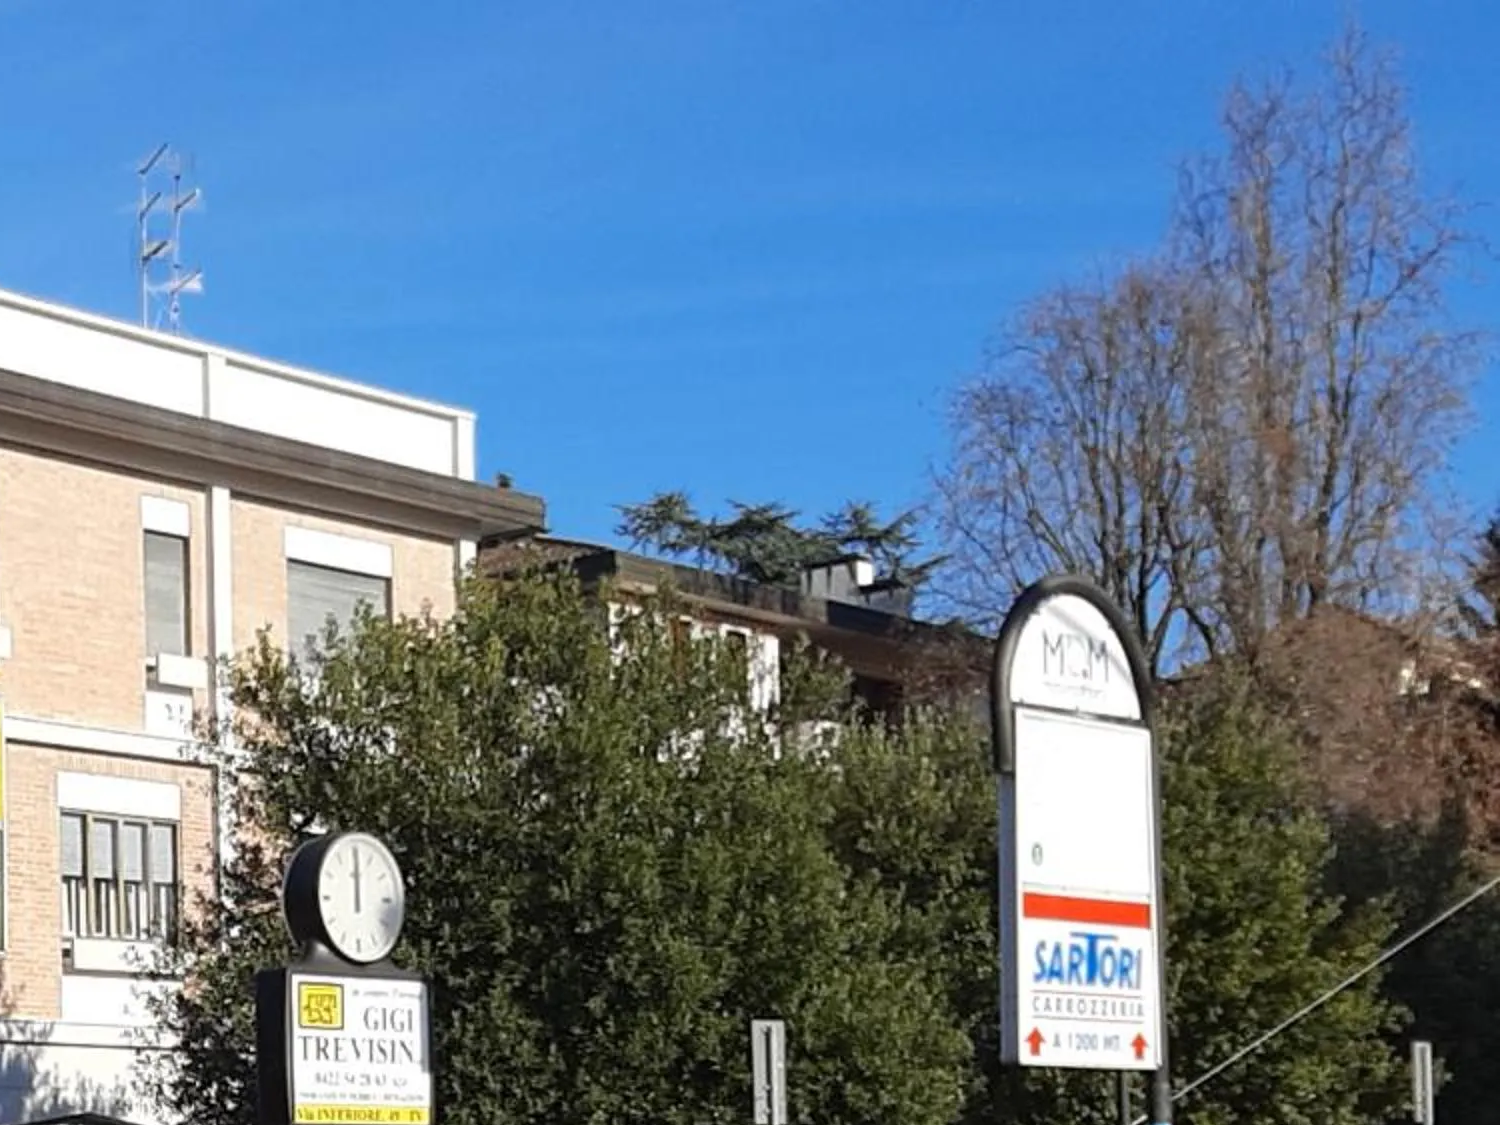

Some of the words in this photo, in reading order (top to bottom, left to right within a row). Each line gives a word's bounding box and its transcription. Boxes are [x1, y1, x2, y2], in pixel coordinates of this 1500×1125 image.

[1032, 931, 1143, 990] SARTORI
[1031, 995, 1145, 1018] CARROZZERIA
[362, 1006, 414, 1033] GIGI
[1052, 1032, 1062, 1049] A
